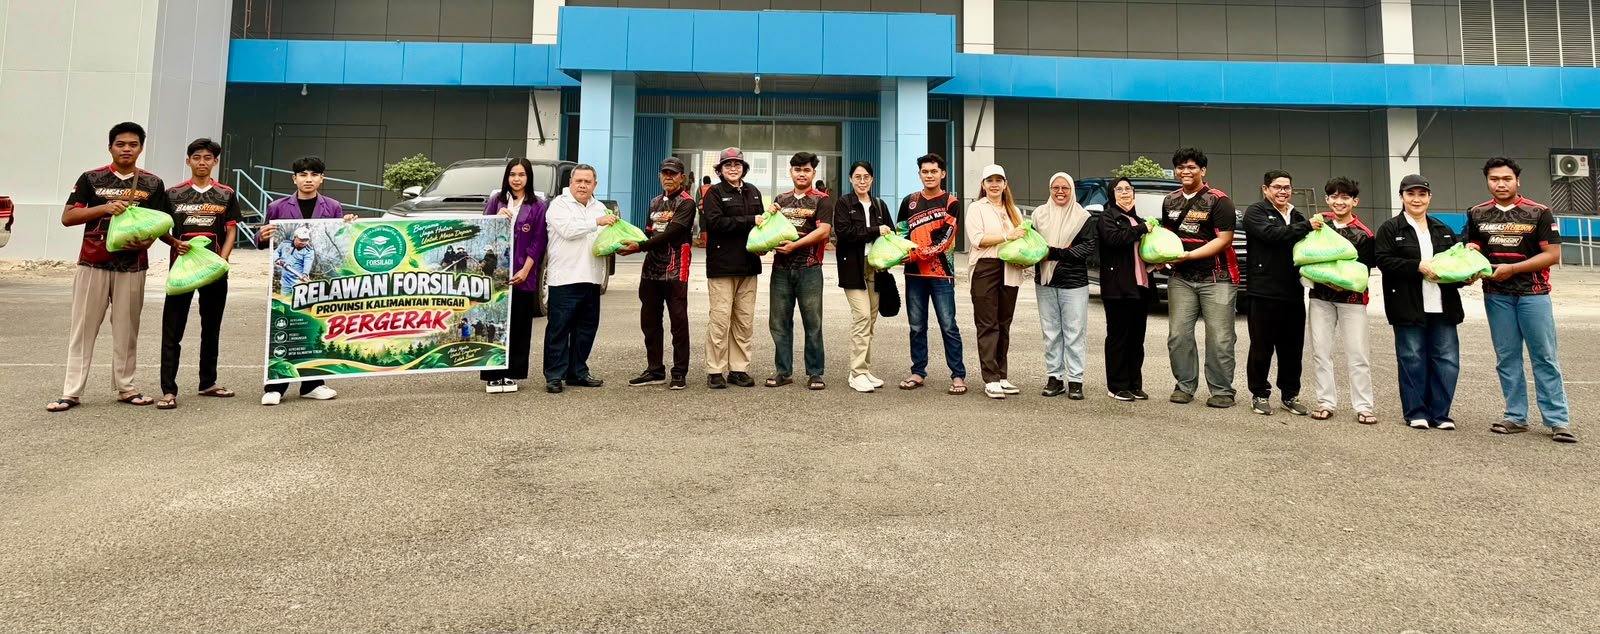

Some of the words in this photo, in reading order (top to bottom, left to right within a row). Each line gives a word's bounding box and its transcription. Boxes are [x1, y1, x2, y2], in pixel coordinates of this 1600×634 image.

[413, 223, 439, 233] Bersama
[435, 226, 453, 234] Hutan
[421, 235, 438, 245] Untuk
[439, 232, 454, 240] Masa
[454, 229, 472, 237] Depan
[293, 273, 388, 308] RELAWAN
[393, 272, 490, 300] FORSILADI
[316, 302, 363, 314] PROVINSI
[366, 297, 429, 310] KALIMANTAN
[431, 297, 465, 307] TENGAH
[324, 310, 452, 339] BERGERAK
